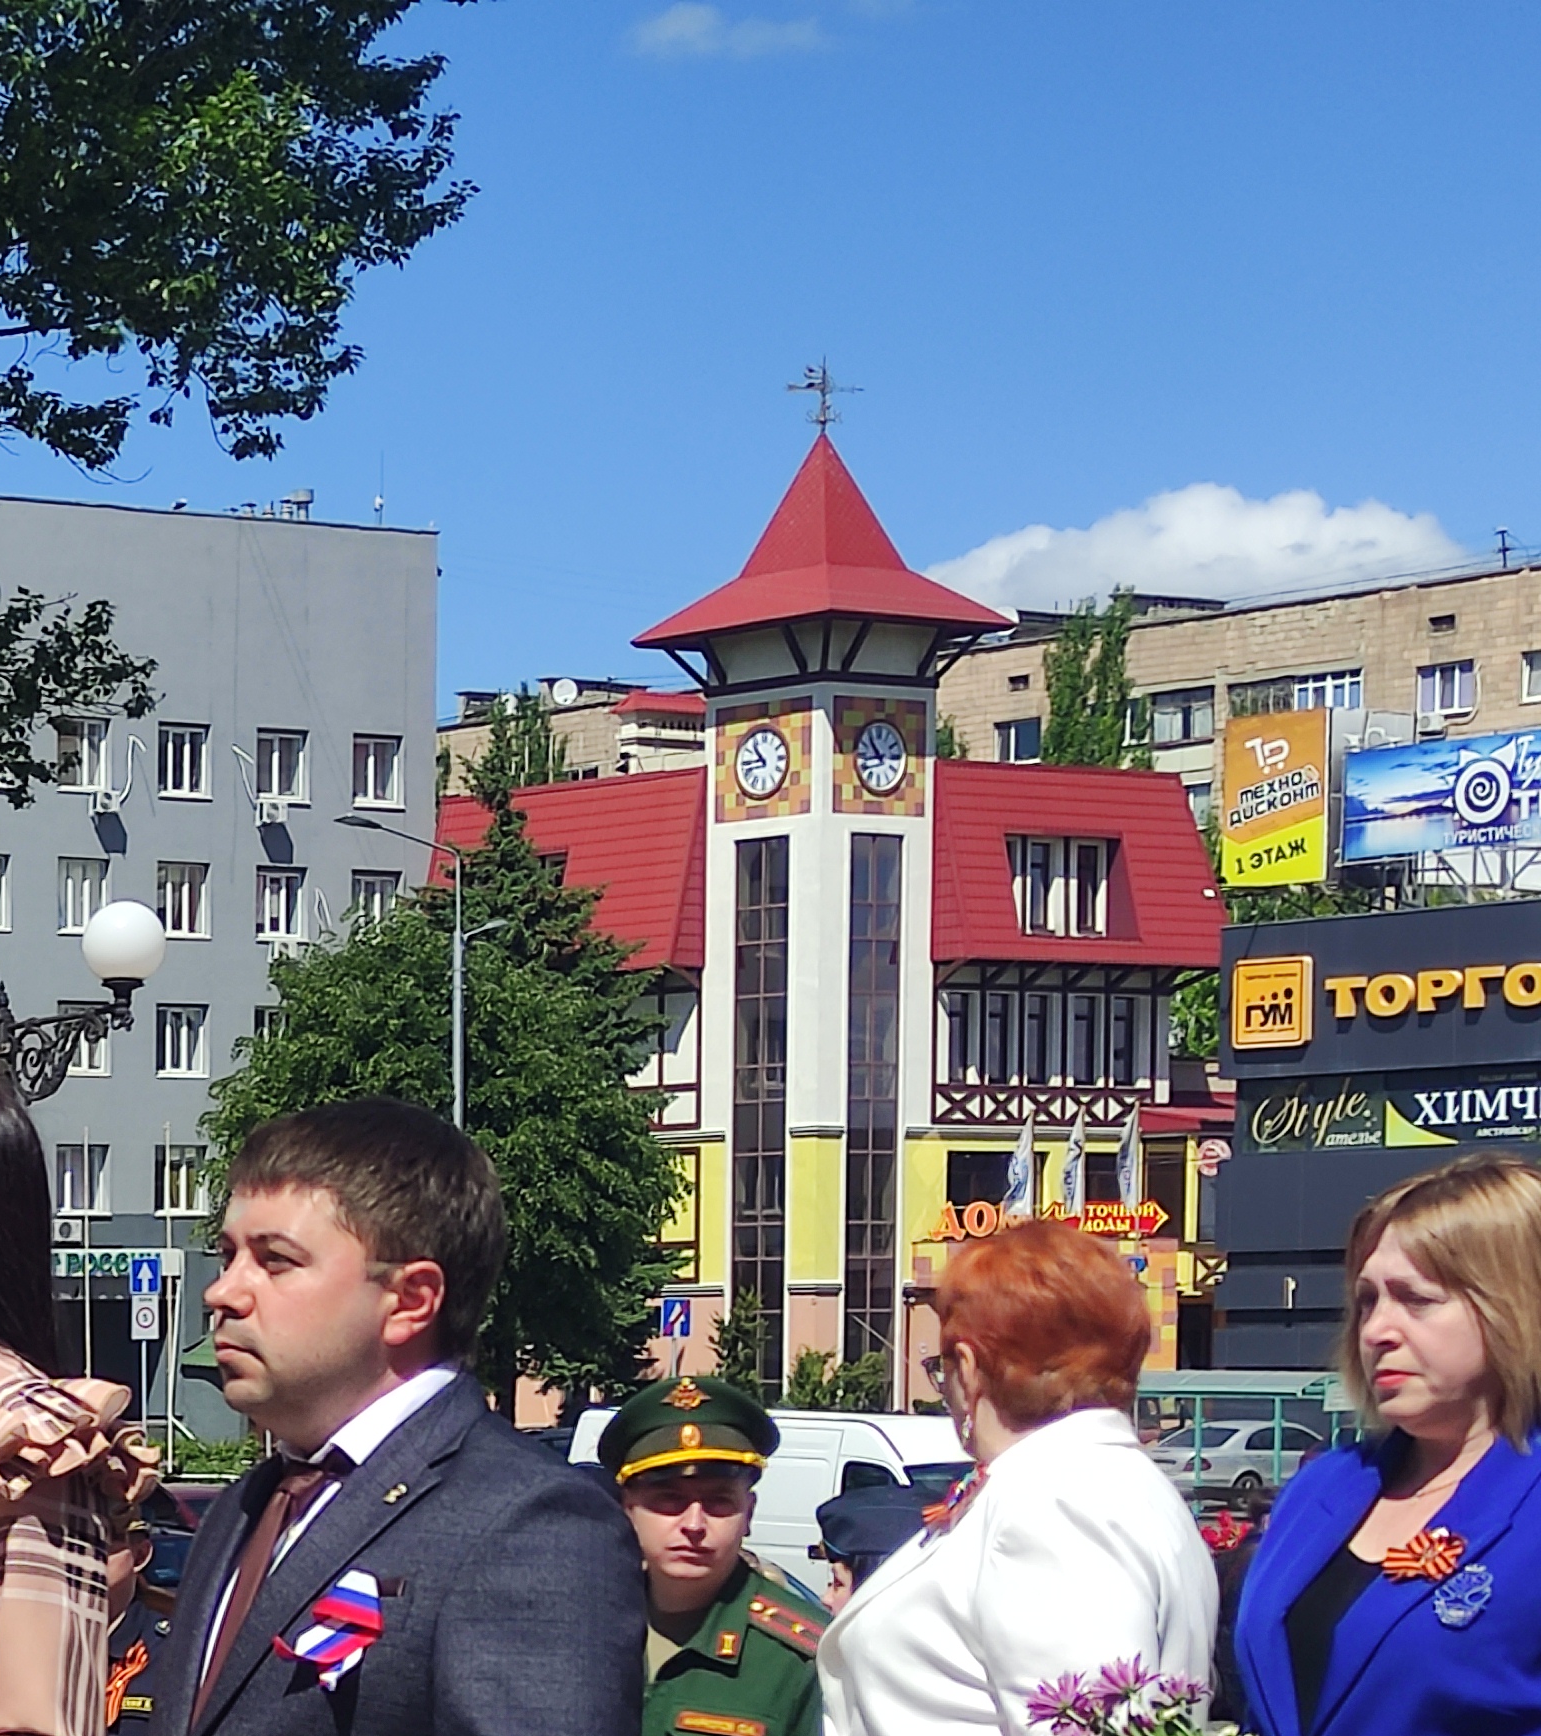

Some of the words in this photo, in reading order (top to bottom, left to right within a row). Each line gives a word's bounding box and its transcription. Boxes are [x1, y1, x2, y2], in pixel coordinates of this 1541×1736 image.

[1229, 783, 1321, 827] ДИСКОНТ
[1443, 823, 1541, 845] ТУРИСТИЧЕС
[1235, 857, 1245, 875] 1
[1249, 837, 1308, 869] ЭТАЖ
[1324, 963, 1541, 1019] ТОРГО
[1245, 1002, 1293, 1028] ГУМ
[1252, 1077, 1367, 1147] Style
[1413, 1086, 1541, 1126] ХИМЧ
[1325, 1130, 1382, 1146] ателье
[1054, 1203, 1155, 1220] ЦТОЧНОЙ
[66, 1252, 161, 1274] РОСС
